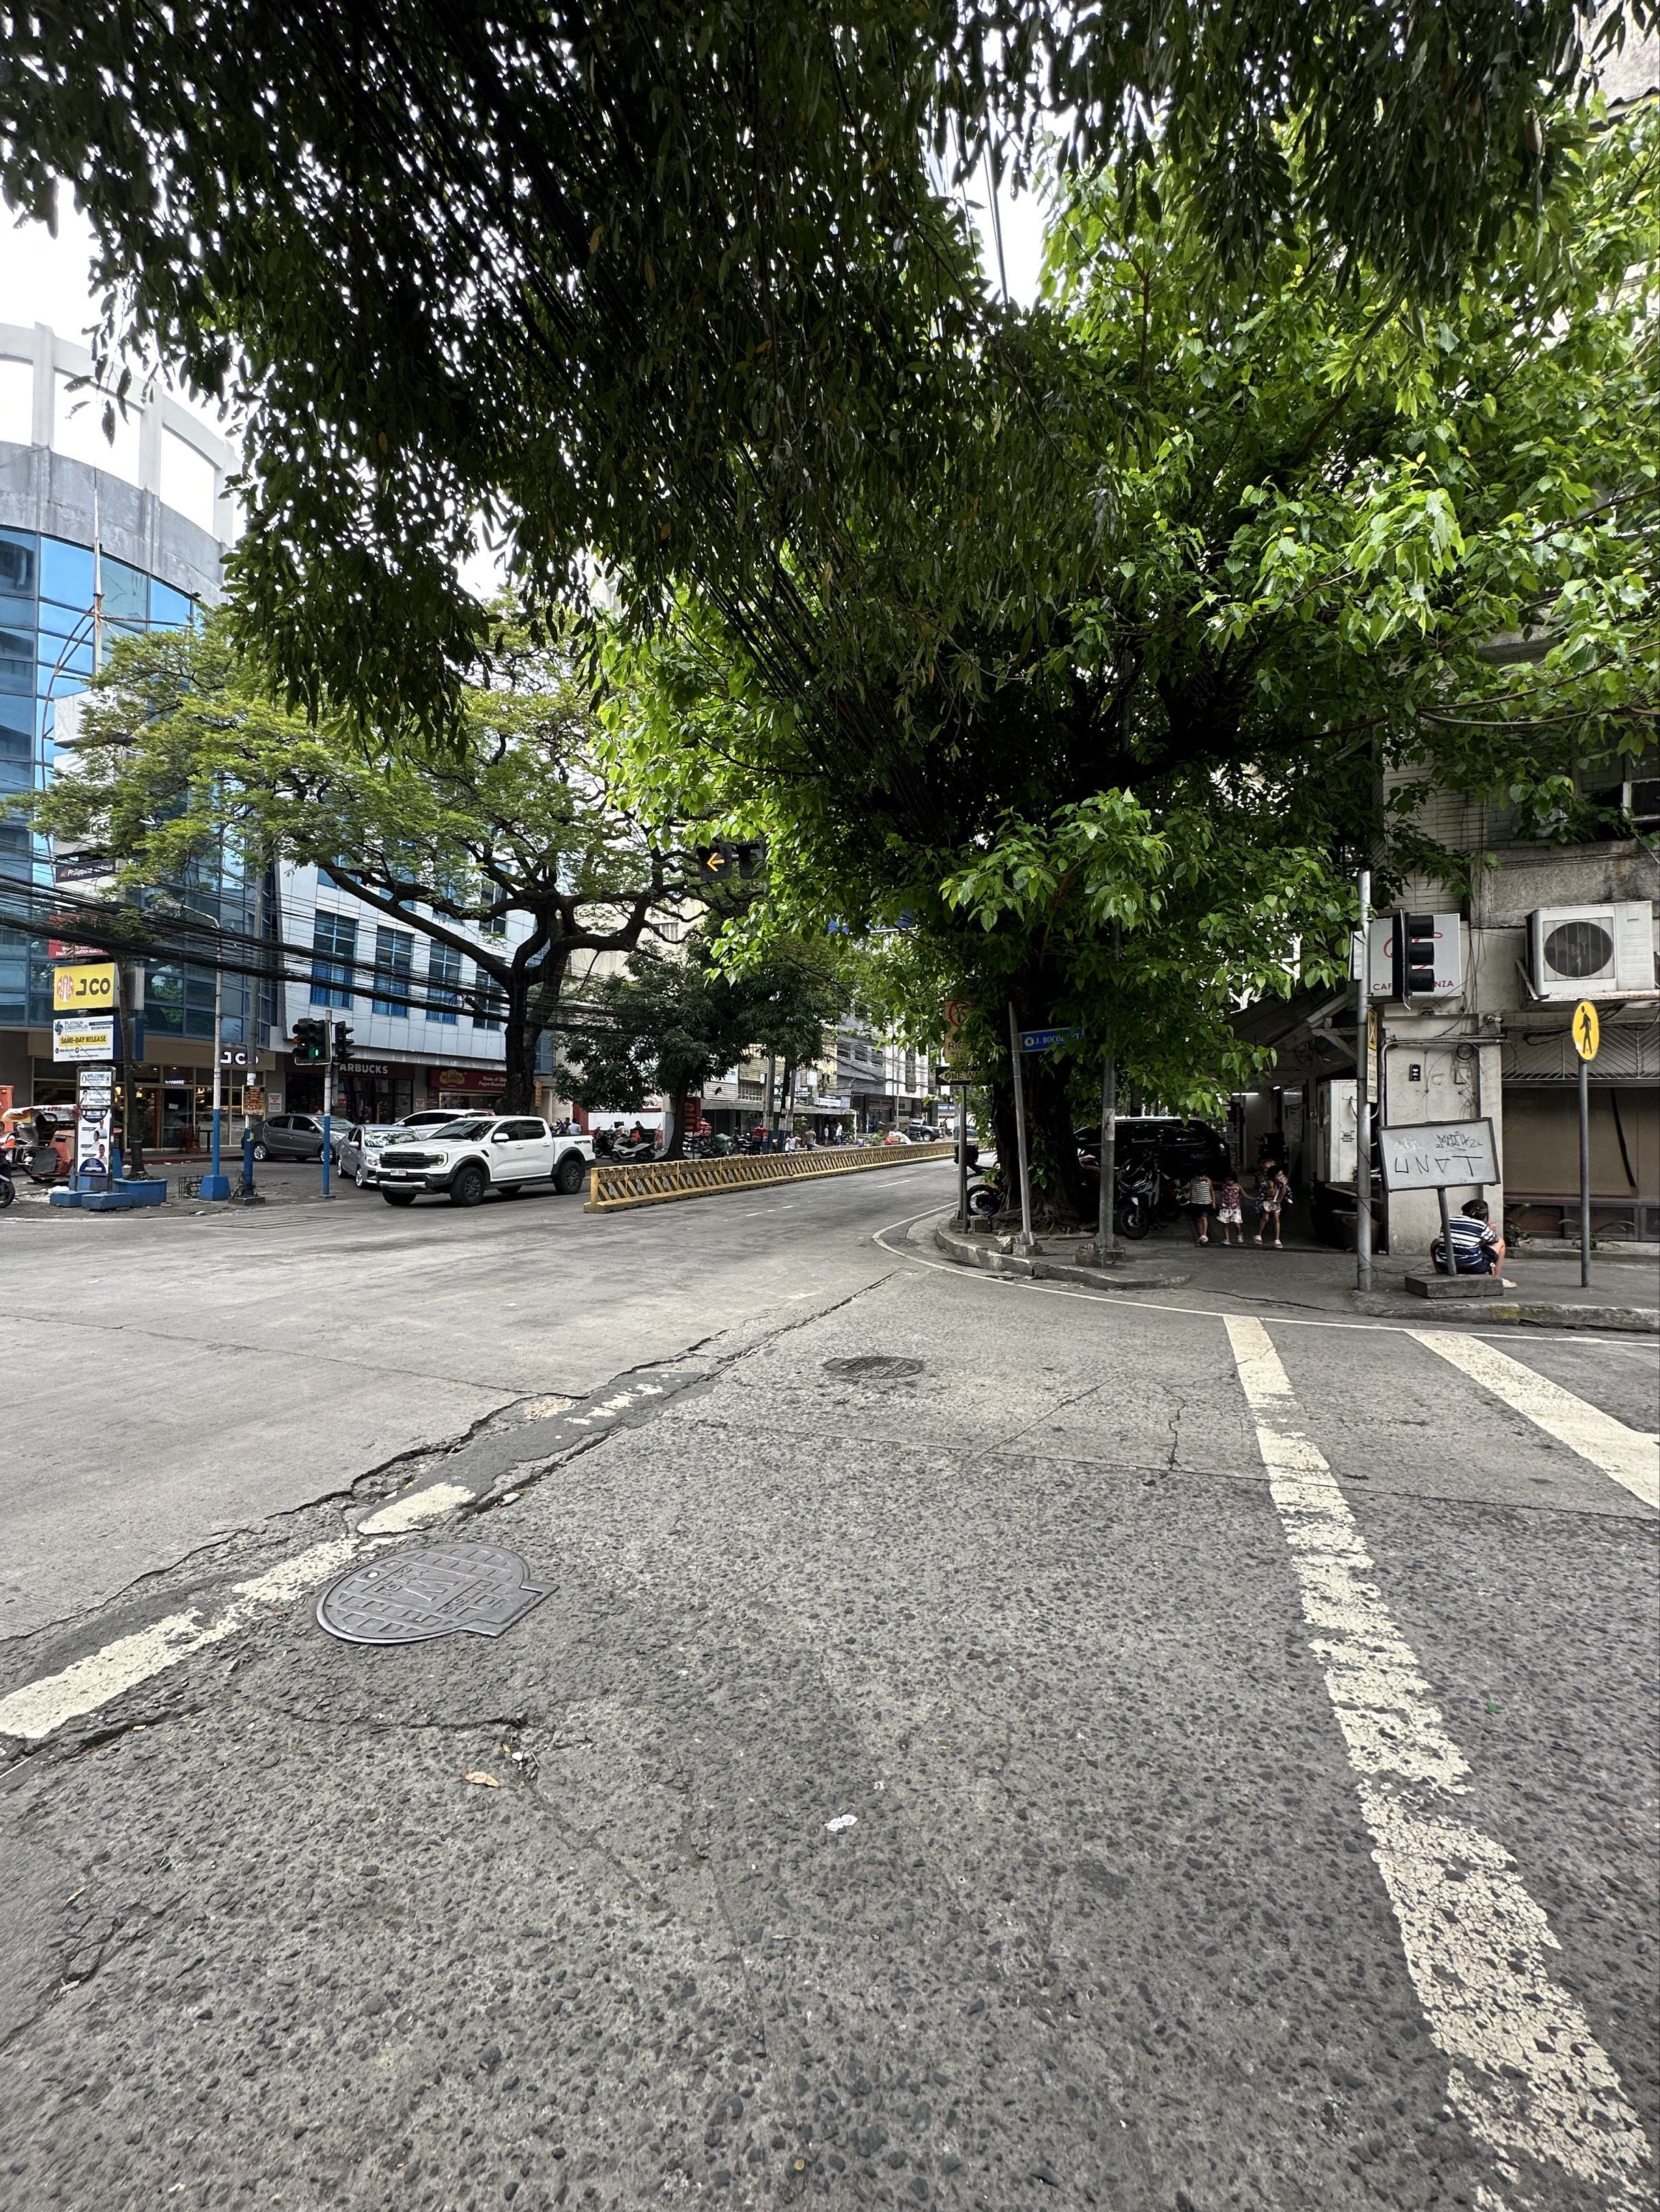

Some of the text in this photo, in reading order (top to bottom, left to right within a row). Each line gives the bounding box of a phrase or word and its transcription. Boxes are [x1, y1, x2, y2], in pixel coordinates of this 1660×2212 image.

[1373, 982, 1392, 991] CAF
[948, 1041, 966, 1050] RIG
[339, 1063, 389, 1075] ARBUCKS
